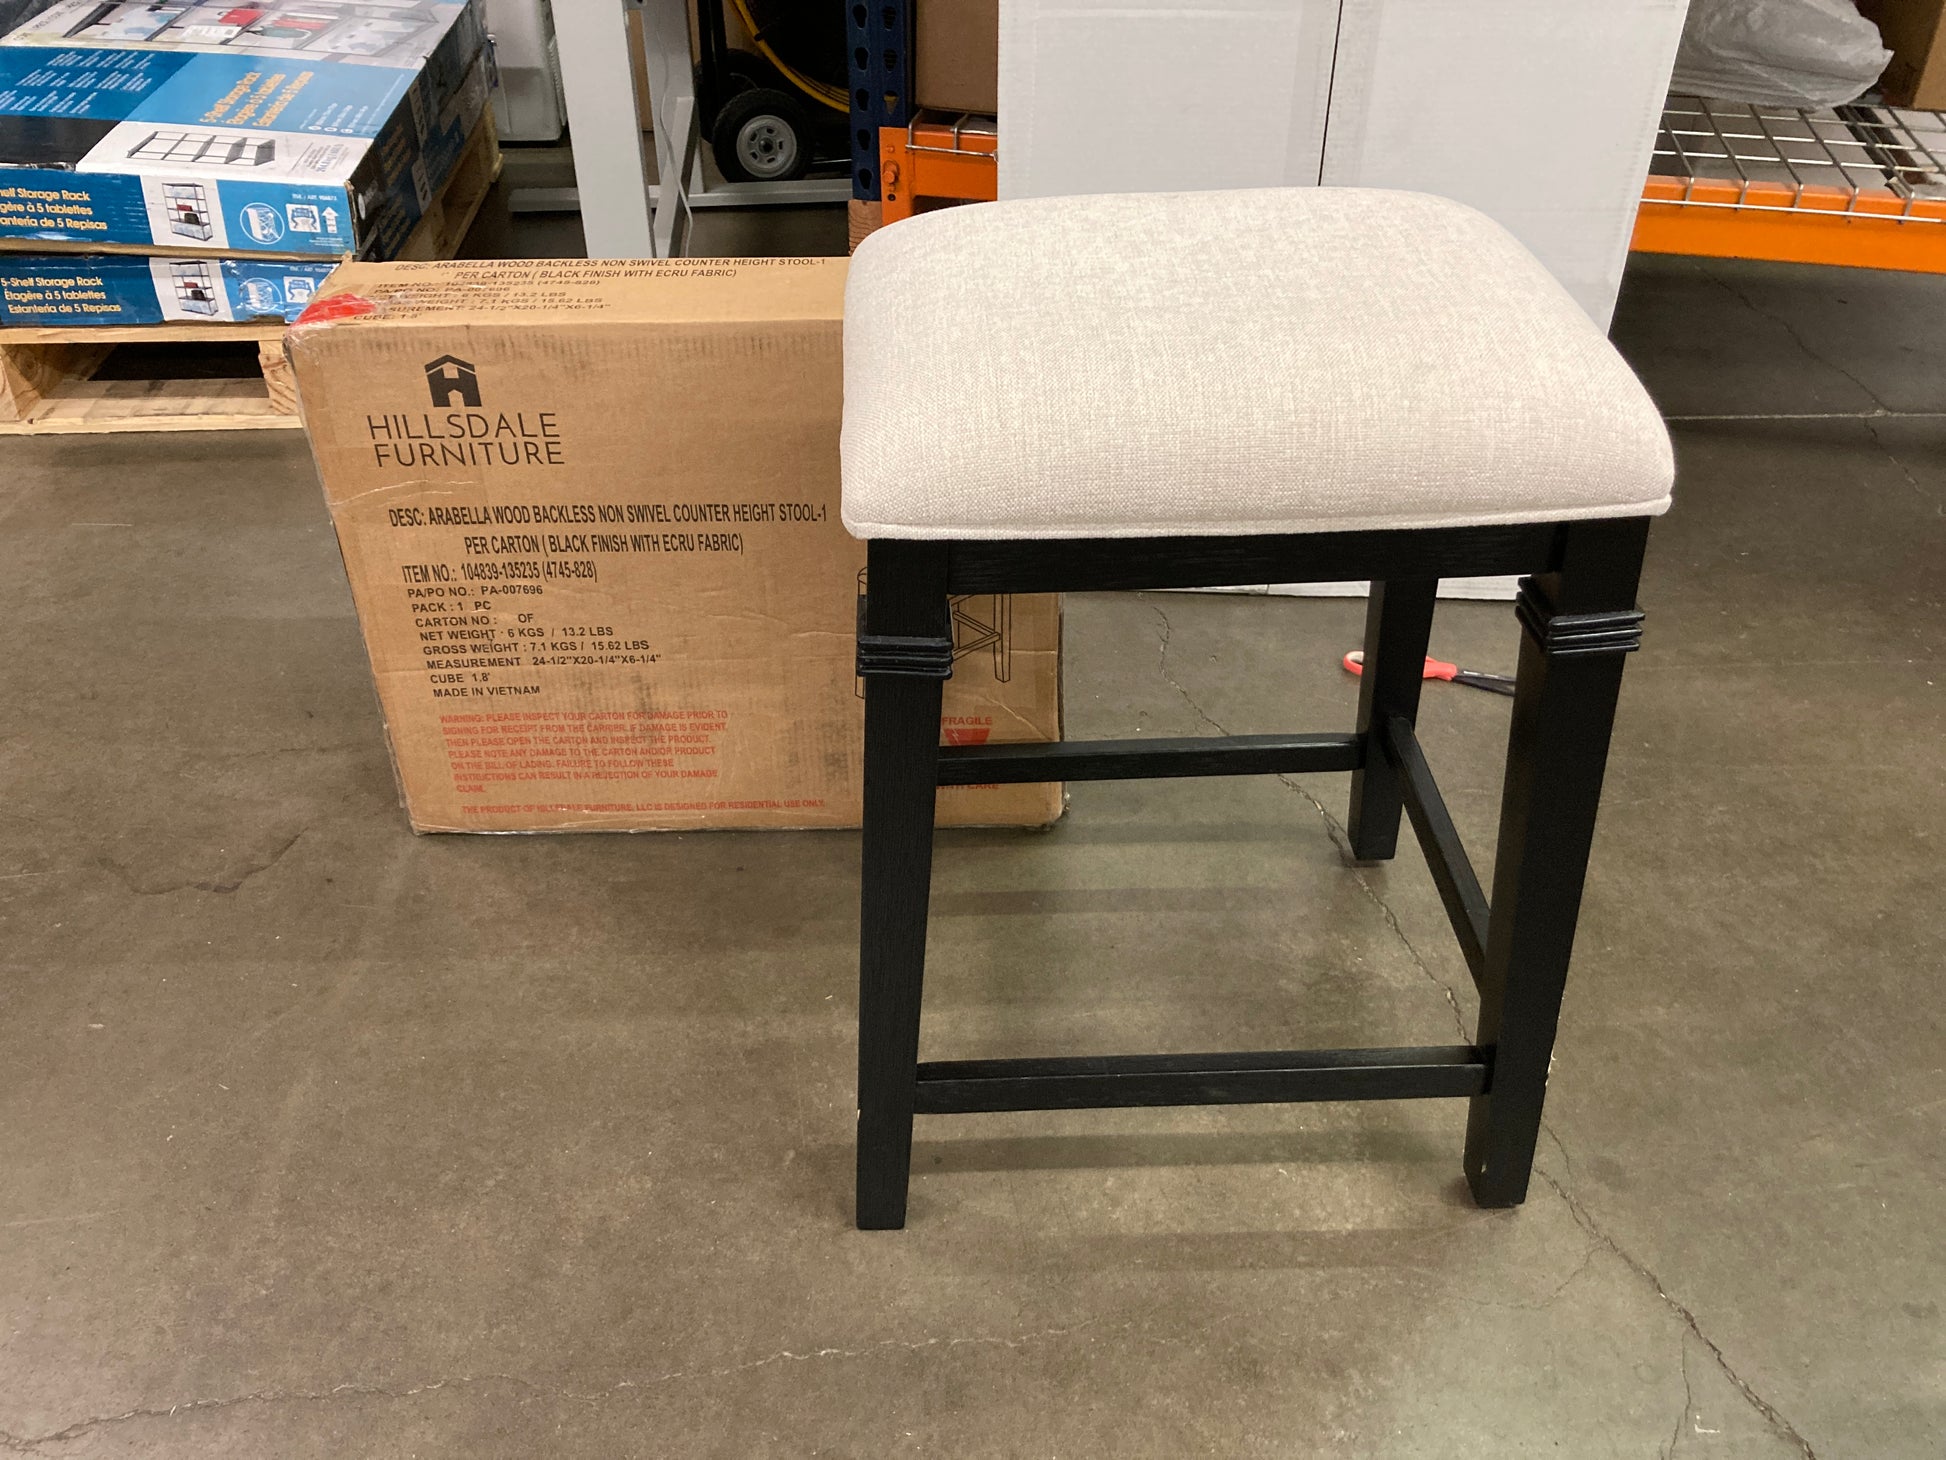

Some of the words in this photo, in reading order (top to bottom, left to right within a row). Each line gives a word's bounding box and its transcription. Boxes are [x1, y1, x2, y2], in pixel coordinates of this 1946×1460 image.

[17, 187, 60, 201] Storage
[61, 189, 91, 201] Rack
[26, 202, 36, 212] à
[37, 203, 44, 213] 5
[45, 203, 93, 215] tablettes
[40, 217, 55, 227] de
[57, 218, 64, 227] 5
[65, 218, 108, 230] Repisas
[432, 261, 494, 269] ARABELLA
[497, 260, 534, 268] WOOD
[600, 259, 627, 267] NON
[733, 258, 776, 266] HEIGHT
[778, 258, 826, 266] STOOL-1
[454, 271, 480, 279] PER
[481, 271, 531, 279] CARTON
[623, 269, 652, 277] WITH
[655, 269, 689, 277] ECRU
[691, 269, 737, 278] FABRIC)
[1, 277, 34, 287] 5-Shelf
[35, 277, 75, 288] Storage
[76, 276, 103, 286] Rack
[45, 290, 53, 300] à
[54, 290, 61, 300] 5
[62, 290, 106, 300] tablettes
[58, 304, 73, 313] de
[74, 303, 81, 313] 5
[82, 303, 121, 314] Repisas
[367, 412, 560, 440] HILLSDALE
[374, 441, 565, 468] FURNITURE
[388, 507, 427, 527] DESC:
[428, 506, 493, 525] ARABELLA
[492, 505, 531, 524] WOOD
[532, 504, 596, 523] BACKLESS
[598, 504, 625, 523] NON
[627, 504, 671, 523] SWIVEL
[673, 503, 731, 522] COUNTER
[733, 503, 776, 522] HEIGHT
[779, 503, 827, 521] STOOL-1
[464, 535, 490, 554] PER
[491, 535, 541, 554] CARTON
[591, 534, 629, 552] FINISH
[630, 534, 660, 552] WITH
[662, 533, 695, 552] ECRU
[698, 533, 744, 555] FABRIC)
[401, 564, 431, 583] ITEM
[460, 561, 541, 581] 104839-135235
[542, 560, 598, 583] (4745-828)
[407, 587, 445, 598] PA/PO
[480, 585, 543, 595] PA-007696
[411, 602, 447, 613] PACK
[457, 602, 463, 611] 1
[474, 601, 491, 610] PC
[415, 616, 467, 627] CARTON
[471, 616, 489, 626] NO
[518, 613, 534, 623] OF
[420, 631, 443, 641] NET
[447, 629, 496, 640] WEIGHT
[507, 628, 515, 638] 6
[518, 627, 545, 637] KGS
[562, 627, 586, 637] 13.2
[589, 626, 614, 637] LBS
[423, 644, 467, 656] GROSS
[470, 642, 519, 653] WEIGHT
[529, 641, 546, 652] 7.1
[550, 641, 578, 651] KGS
[591, 641, 621, 651] 15.62
[624, 640, 650, 650] LBS
[426, 657, 521, 669] MEASUREMENT
[430, 673, 464, 684] CUBE
[433, 687, 469, 697] MADE
[472, 687, 484, 696] IN
[486, 686, 540, 696] VIETNAM
[439, 714, 484, 723] WARNING:
[486, 713, 521, 721] PLEASE
[523, 712, 559, 721] INSPECT
[562, 712, 586, 721] YOUR
[588, 711, 625, 720] CARTON
[627, 711, 645, 720] FOR
[647, 711, 687, 719] DAMAGE
[687, 710, 714, 719] PRIOR
[716, 710, 728, 719] TO
[942, 716, 993, 725] FRAGILE
[442, 727, 479, 735] SIGNING
[481, 726, 499, 734] FOR
[501, 725, 537, 733] RECEIPT
[540, 725, 566, 733] FROM
[567, 724, 585, 733] THE
[630, 724, 637, 732] IF
[639, 723, 677, 732] DAMAGE
[679, 723, 687, 731] IS
[445, 738, 469, 747] THEN
[471, 738, 504, 746] PLEASE
[506, 737, 531, 745] OPEN
[533, 736, 551, 745] THE
[552, 736, 588, 744] CARTON
[590, 736, 608, 744] AND
[610, 735, 646, 744] INSPECT
[648, 735, 667, 743] THE
[448, 750, 482, 758] PLEASE
[484, 749, 508, 757] NOTE
[510, 749, 527, 757] ANY
[529, 748, 567, 756] DAMAGE
[570, 748, 581, 756] TO
[584, 748, 599, 756] THE
[602, 747, 637, 756] CARTON
[674, 746, 716, 755] PRODUCT
[451, 762, 464, 770] ON
[466, 761, 482, 769] THE
[484, 761, 504, 769] BILL
[505, 761, 518, 769] OF
[556, 760, 592, 768] FAILURE
[594, 759, 606, 768] TO
[608, 759, 644, 767] FOLLOW
[646, 758, 674, 767] THESE
[453, 773, 517, 781] INSTRUCTIONS
[518, 772, 537, 780] CAN
[538, 771, 571, 780] RESULT
[574, 771, 582, 779] IN
[592, 771, 639, 779] REJECTION
[641, 770, 652, 778] OF
[654, 770, 679, 778] YOUR
[681, 769, 718, 778] DAMAGE
[462, 805, 480, 814] THE
[480, 805, 520, 813] PRODUCT
[636, 803, 652, 811] LLC
[654, 803, 663, 811] IS
[664, 802, 707, 811] DESIGNED
[709, 802, 727, 810] FOR
[728, 801, 782, 809] RESIDENTIAL
[783, 800, 800, 808] USE
